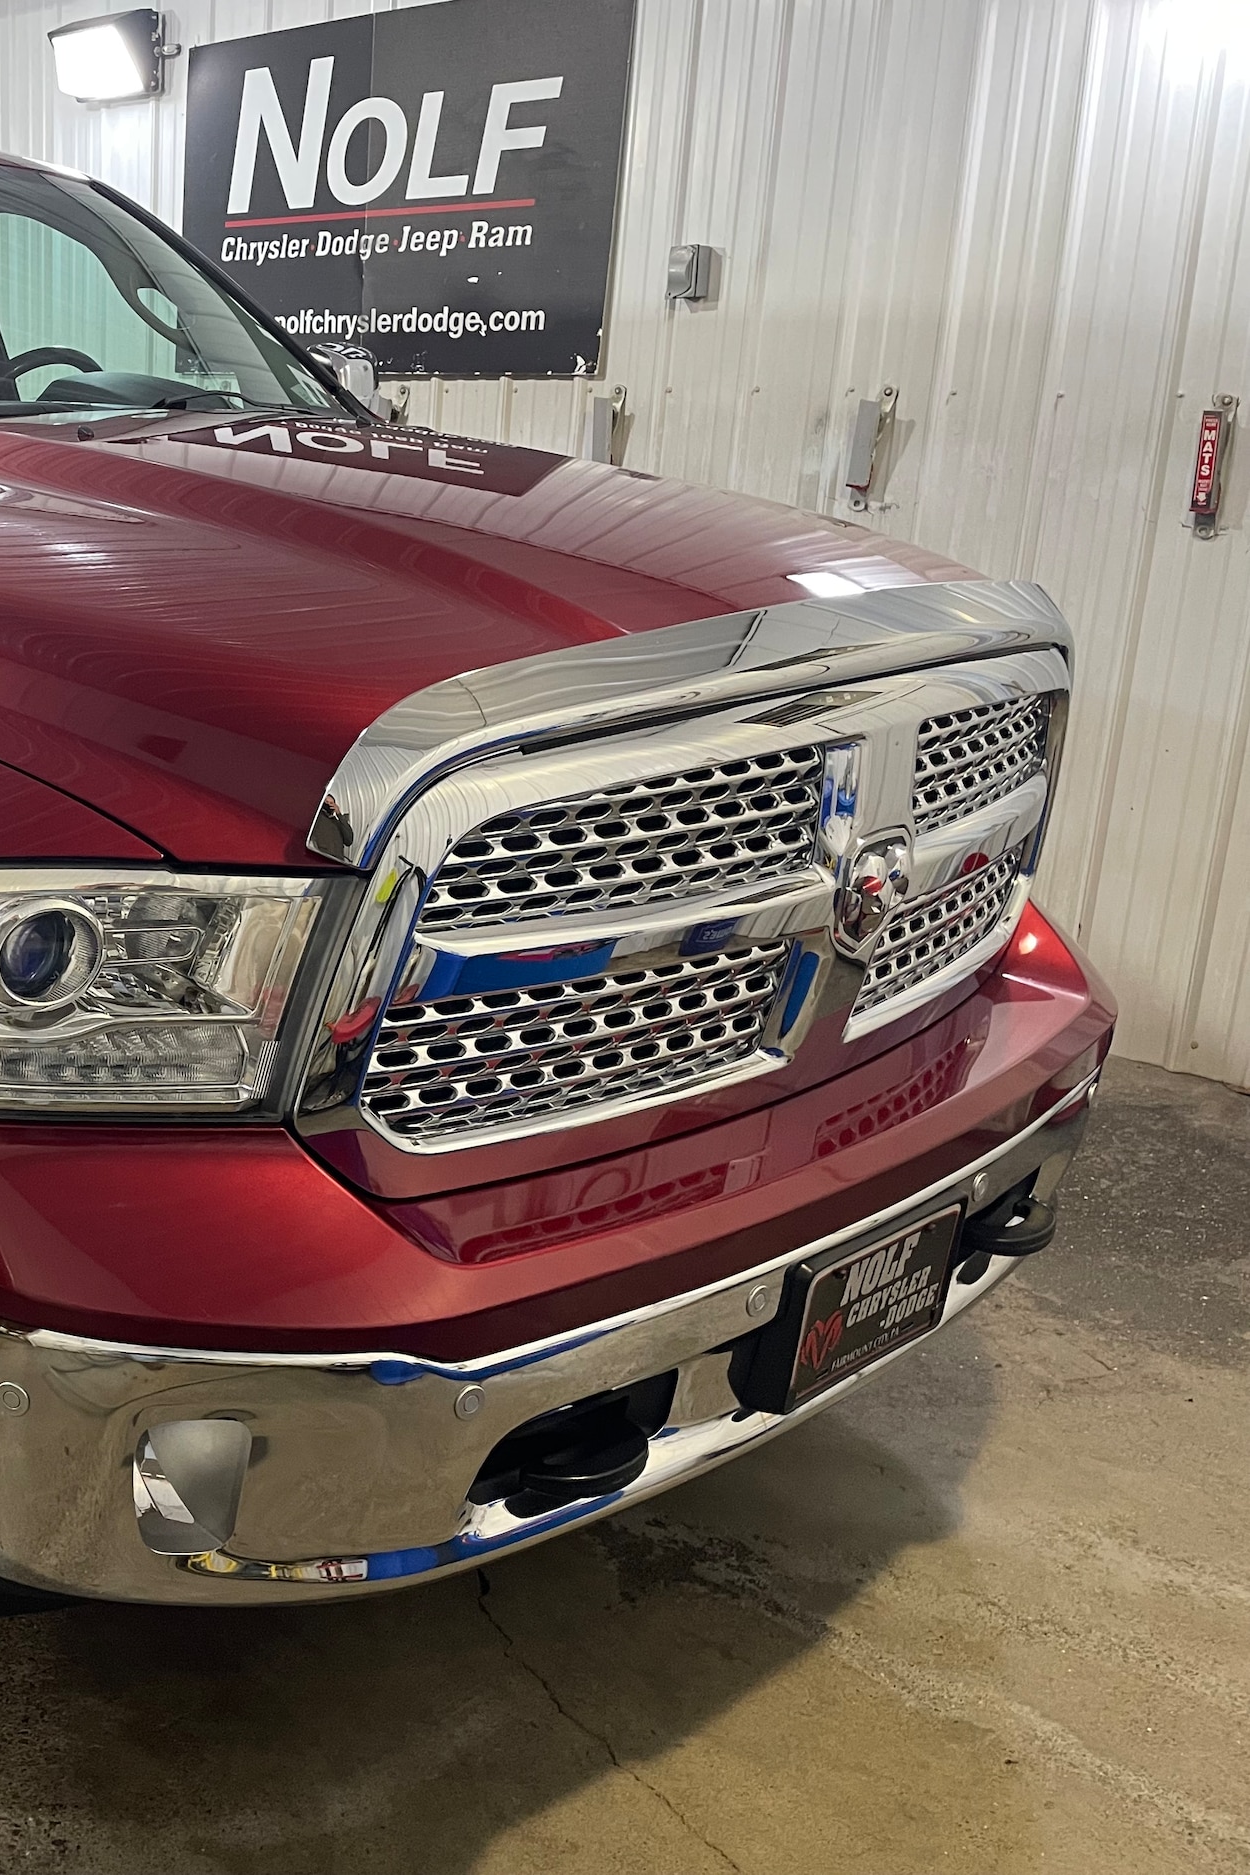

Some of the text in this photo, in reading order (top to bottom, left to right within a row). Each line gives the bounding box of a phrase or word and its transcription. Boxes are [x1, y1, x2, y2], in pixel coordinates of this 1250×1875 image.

[227, 55, 564, 215] NOLF
[220, 220, 533, 266] Chrysler Dodge Jeep Ram
[1200, 430, 1217, 476] MATS
[840, 1231, 922, 1307] NOLF
[846, 1265, 932, 1328] CHRYSLER
